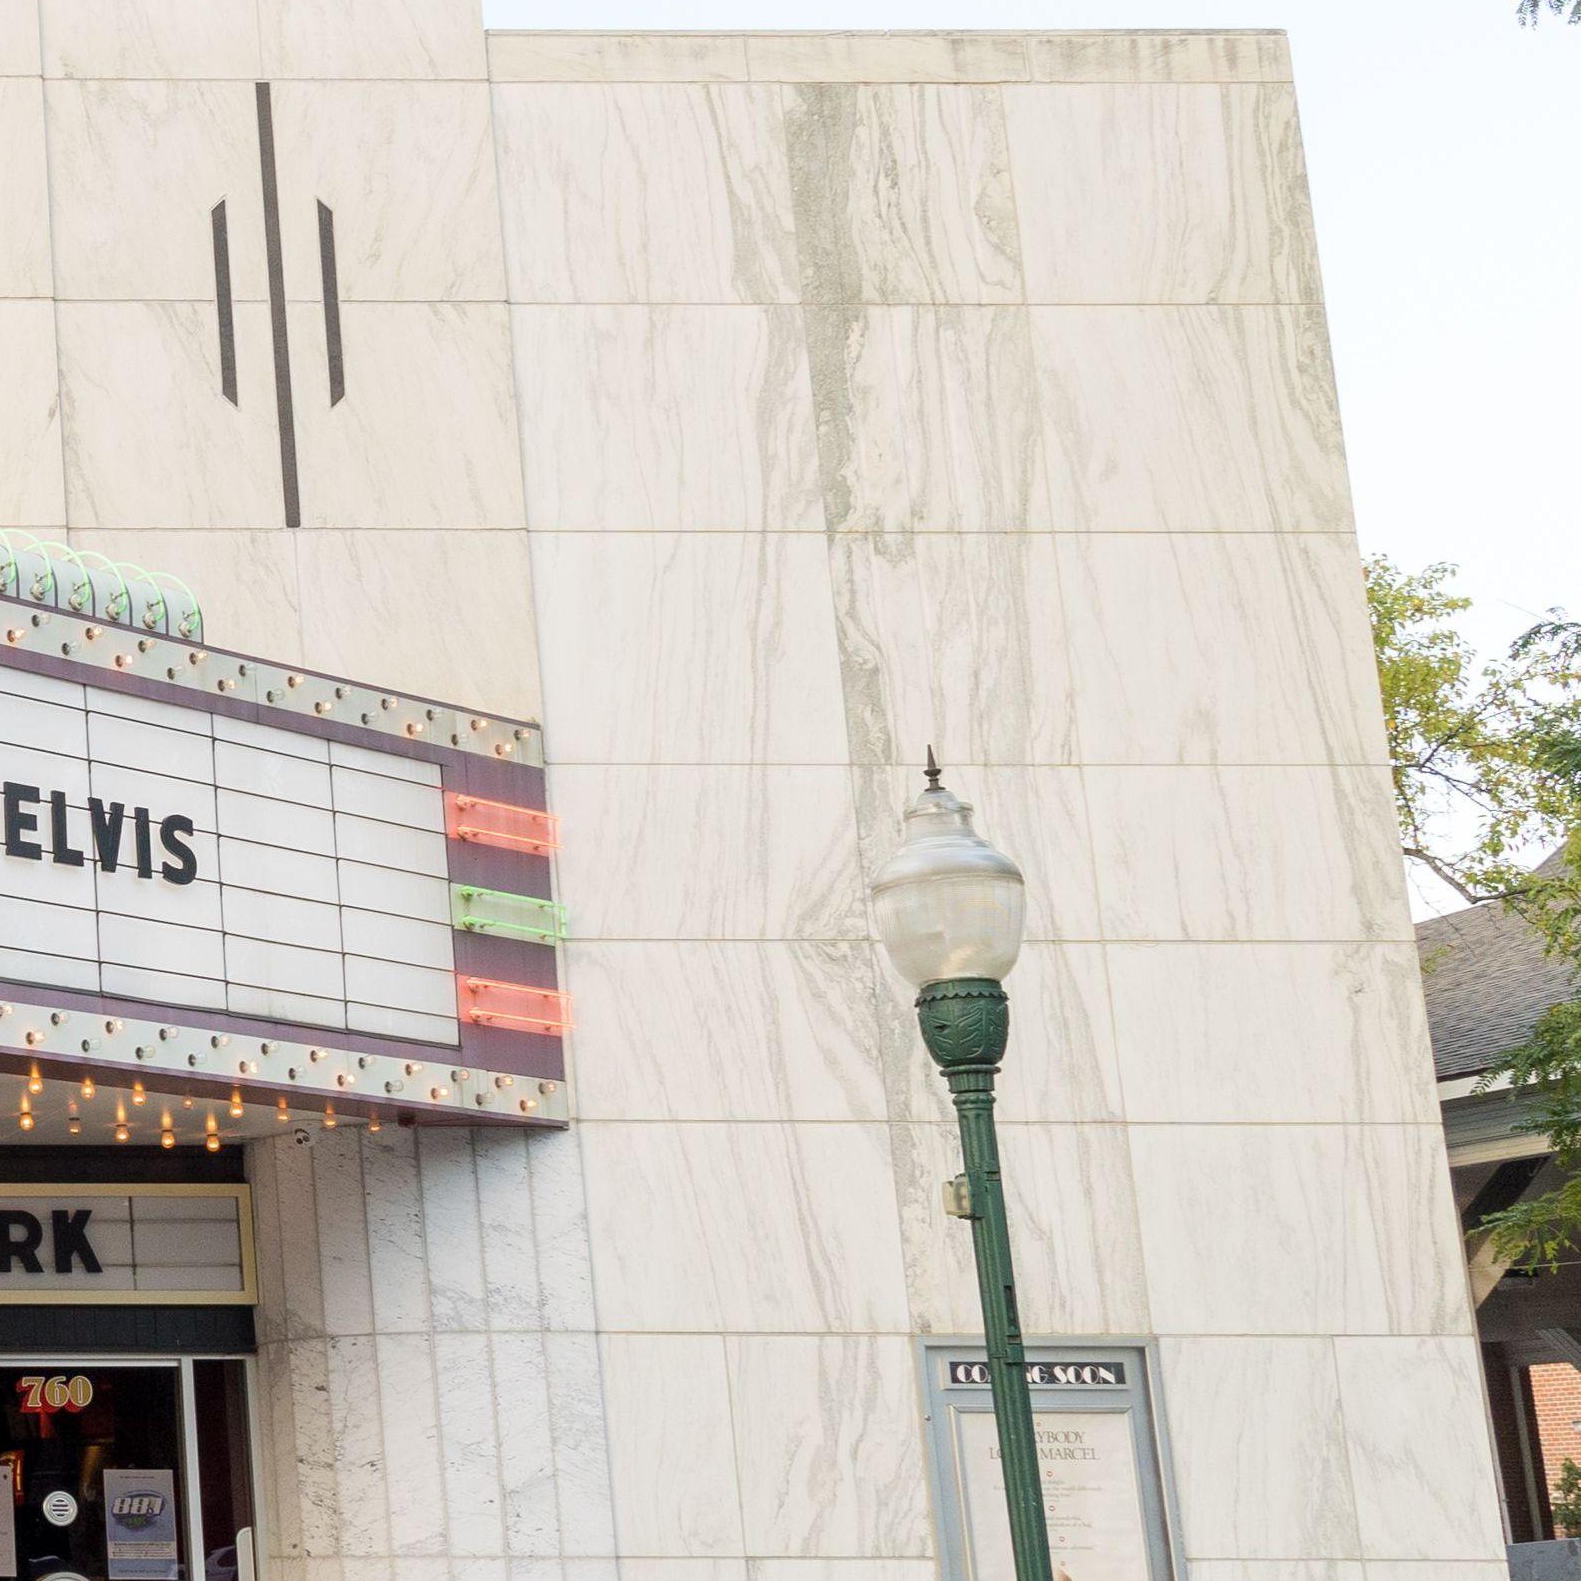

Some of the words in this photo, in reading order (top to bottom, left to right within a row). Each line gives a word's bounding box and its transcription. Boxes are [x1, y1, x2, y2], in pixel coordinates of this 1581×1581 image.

[3, 781, 198, 886] ELVIS
[1053, 1365, 1116, 1385] SOON
[18, 1375, 93, 1410] 760
[1040, 1447, 1101, 1461] MARCEL
